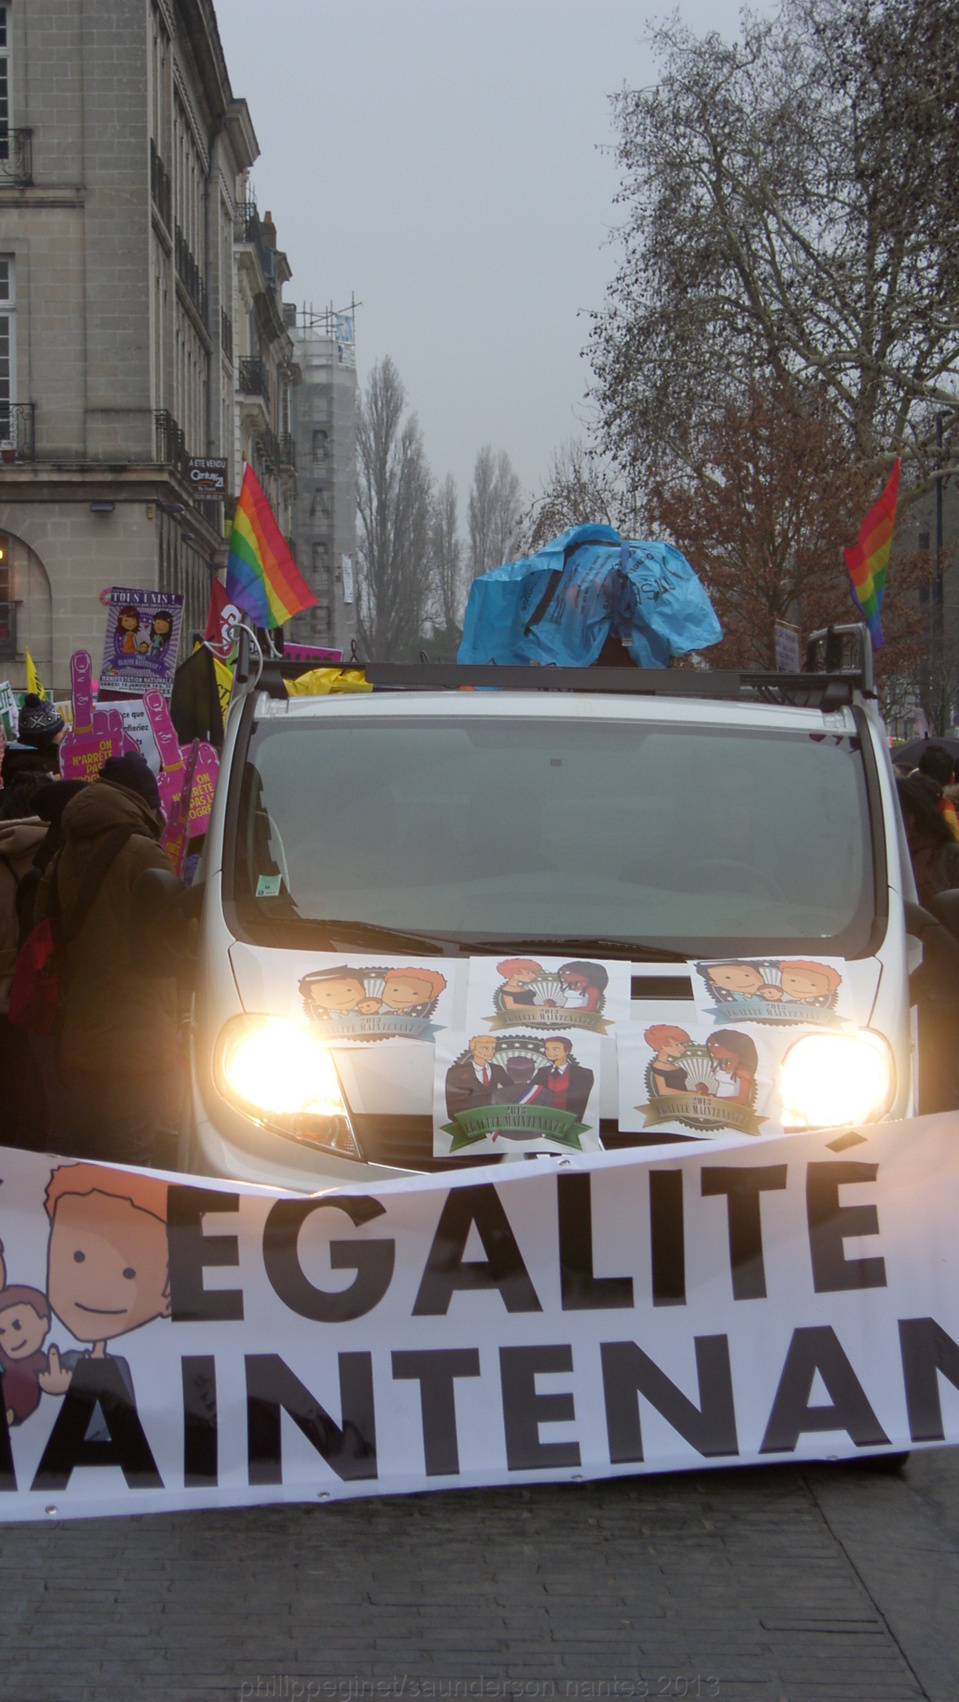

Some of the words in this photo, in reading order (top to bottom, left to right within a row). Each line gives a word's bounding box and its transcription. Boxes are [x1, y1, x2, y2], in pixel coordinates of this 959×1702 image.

[190, 469, 219, 481] Century
[215, 477, 224, 487] 21
[113, 592, 140, 602] TOUS
[144, 593, 168, 604] UNIS
[171, 594, 176, 604] !
[99, 739, 112, 750] ON
[196, 773, 210, 784] ON
[190, 796, 206, 808] PAS
[692, 1097, 712, 1106] 2013
[505, 1106, 527, 1115] 2013
[657, 1102, 690, 1115] ÉGALITÉ
[505, 1115, 562, 1133] MAINTENANT
[0, 1317, 959, 1491] AINTENA
